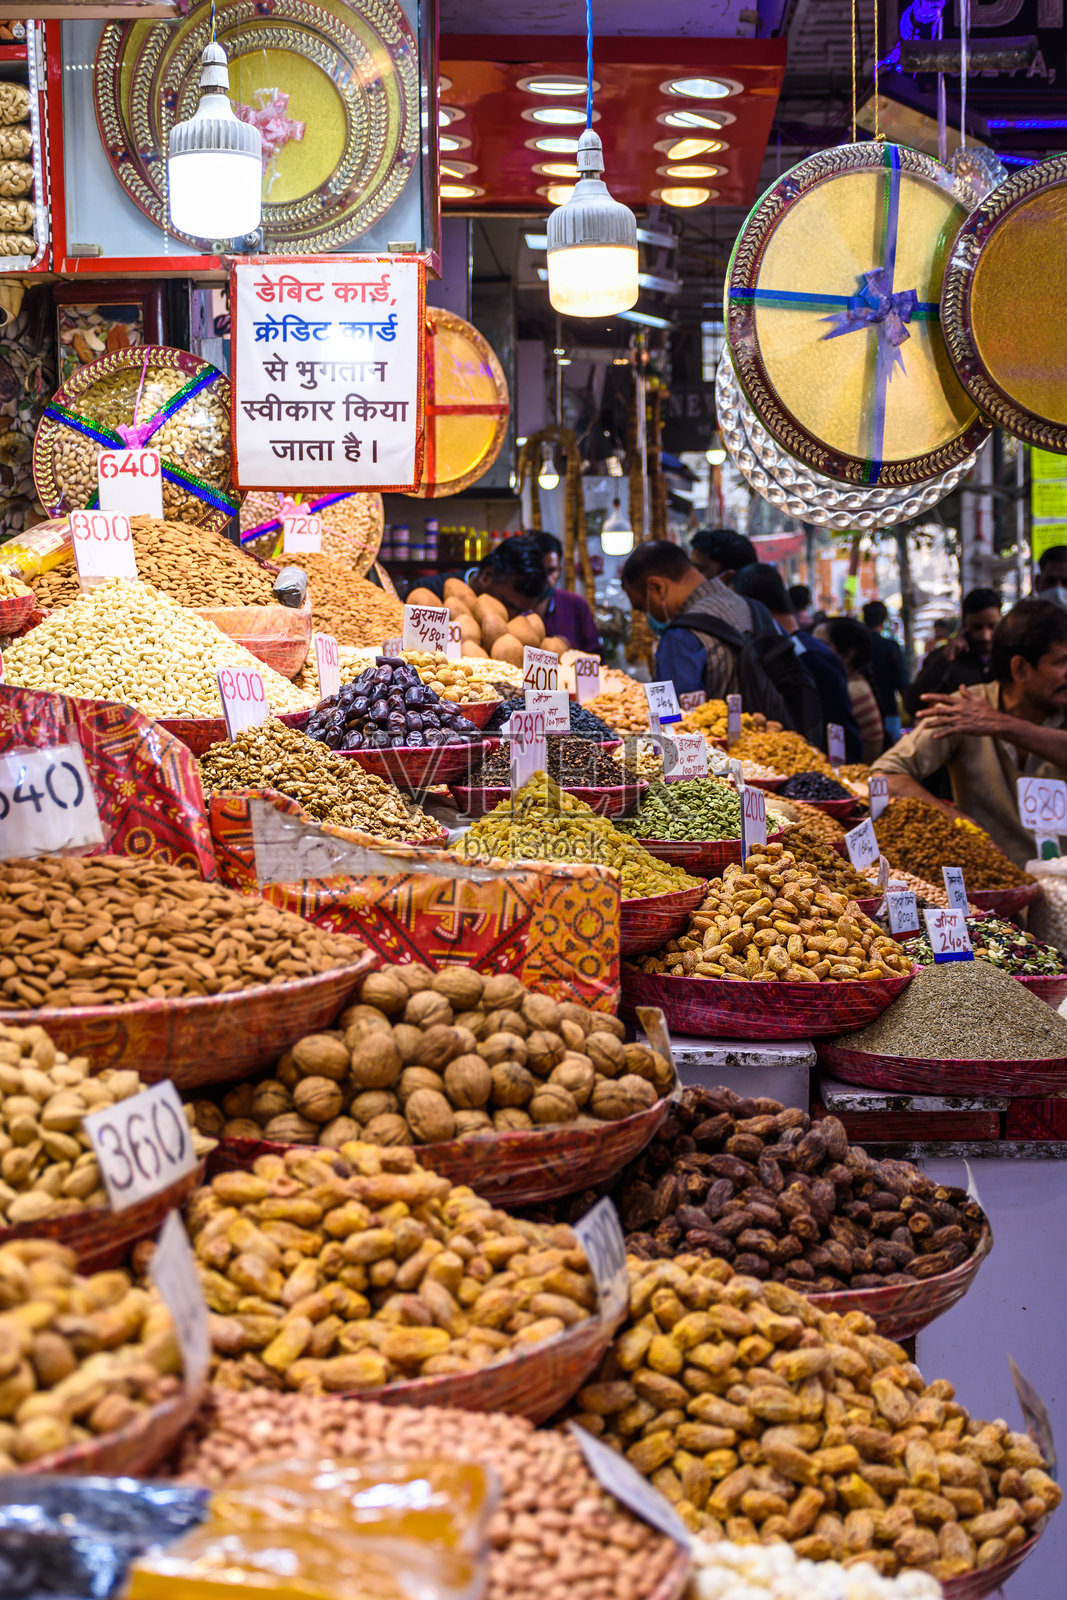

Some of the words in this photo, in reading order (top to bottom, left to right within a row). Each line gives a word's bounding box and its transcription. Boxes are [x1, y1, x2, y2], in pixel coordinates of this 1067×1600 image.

[253, 273, 325, 303] डेबिट
[331, 274, 397, 307] कार्ड,
[252, 313, 332, 342] क्रेडिट
[338, 313, 399, 342] कार्ड
[262, 352, 288, 382] से
[295, 361, 389, 390] भुगतान
[240, 393, 336, 422] स्वीकार
[342, 393, 410, 422] किया
[269, 440, 335, 461] जाता
[99, 452, 160, 479] 640
[73, 513, 131, 542] 800
[284, 517, 320, 535] 720
[317, 637, 339, 667] 780
[524, 663, 558, 690] 400
[575, 659, 600, 677] 280
[221, 669, 265, 702] 800
[514, 713, 545, 745] 280
[744, 787, 766, 823] 200
[1024, 780, 1066, 821] 680
[934, 911, 958, 929] जीरा
[97, 1098, 185, 1191] 360
